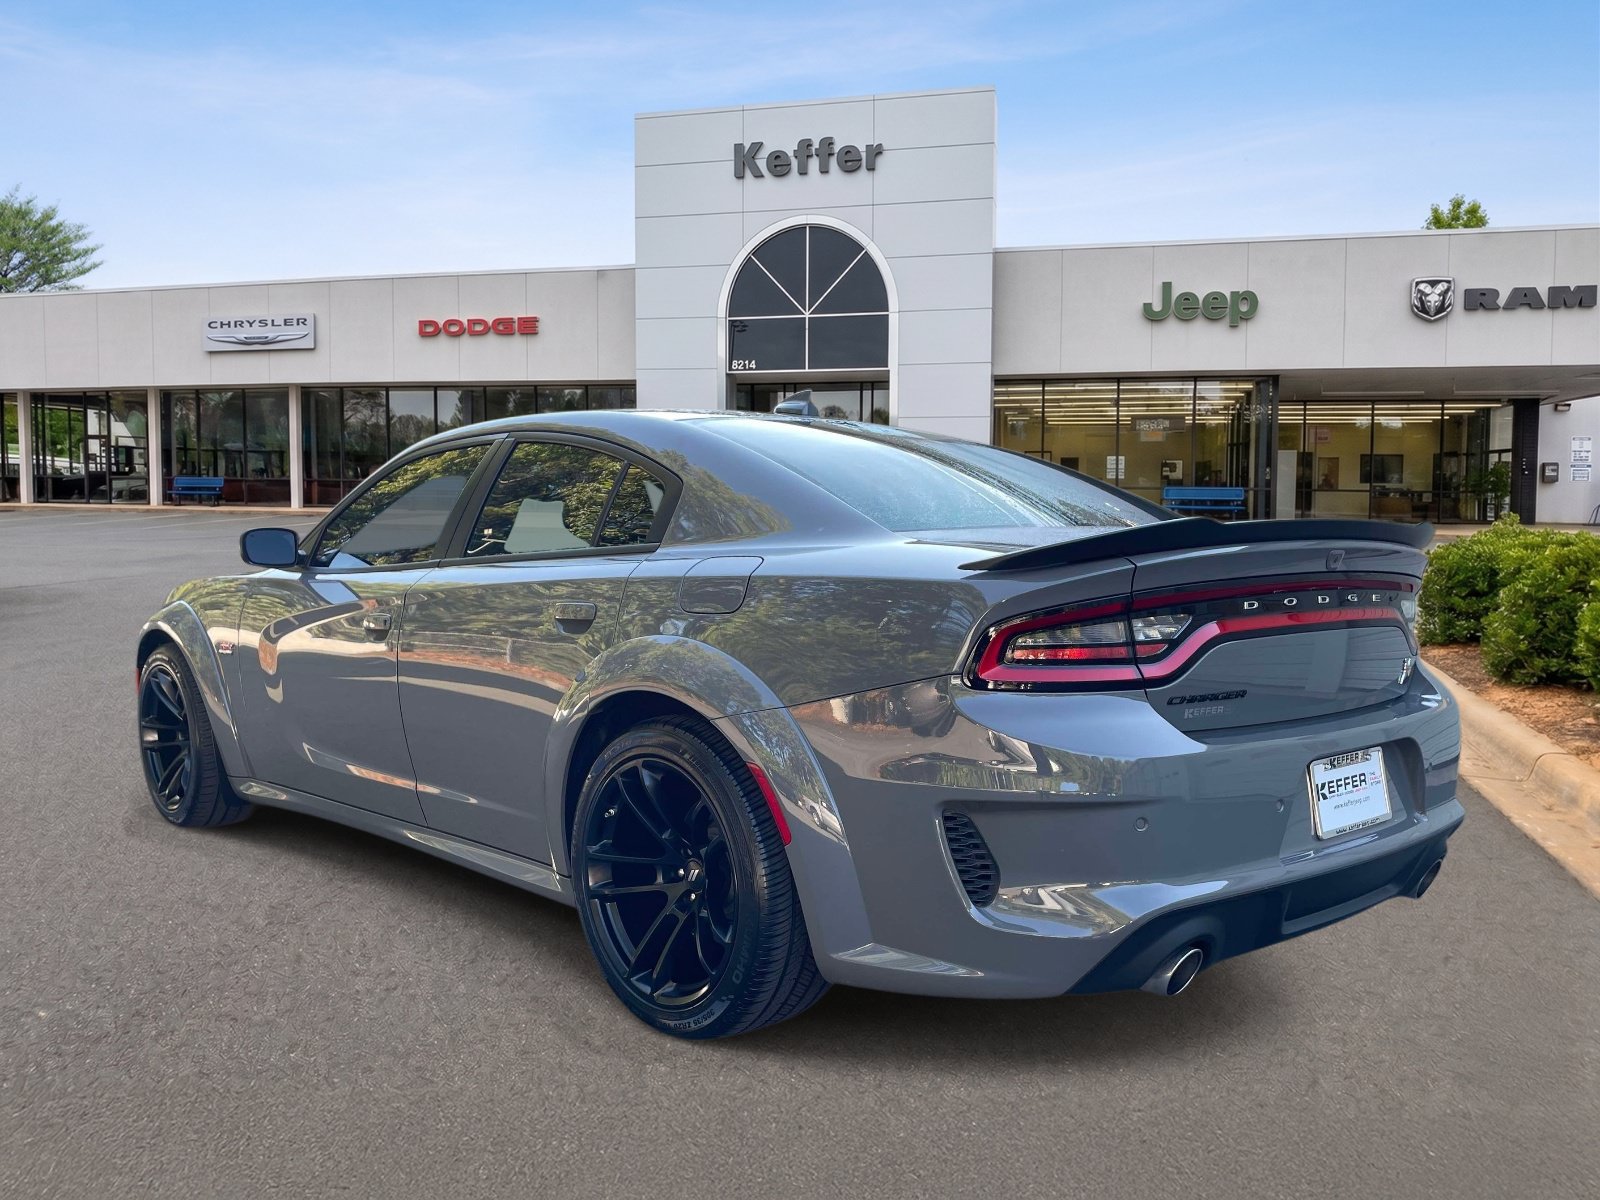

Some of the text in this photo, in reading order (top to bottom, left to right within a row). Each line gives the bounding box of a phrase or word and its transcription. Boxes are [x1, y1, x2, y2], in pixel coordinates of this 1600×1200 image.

[734, 137, 884, 179] Keffer
[1143, 281, 1259, 328] Jeep
[1464, 285, 1598, 310] RAM
[207, 317, 308, 329] CHRYSLER
[418, 316, 539, 337] DODGE
[731, 359, 757, 370] 8214
[1243, 593, 1381, 610] DODGE
[1166, 689, 1248, 706] CHARGER
[1184, 705, 1224, 719] KEFFER
[1329, 752, 1360, 769] KEFFER
[1316, 772, 1368, 802] KEFFER
